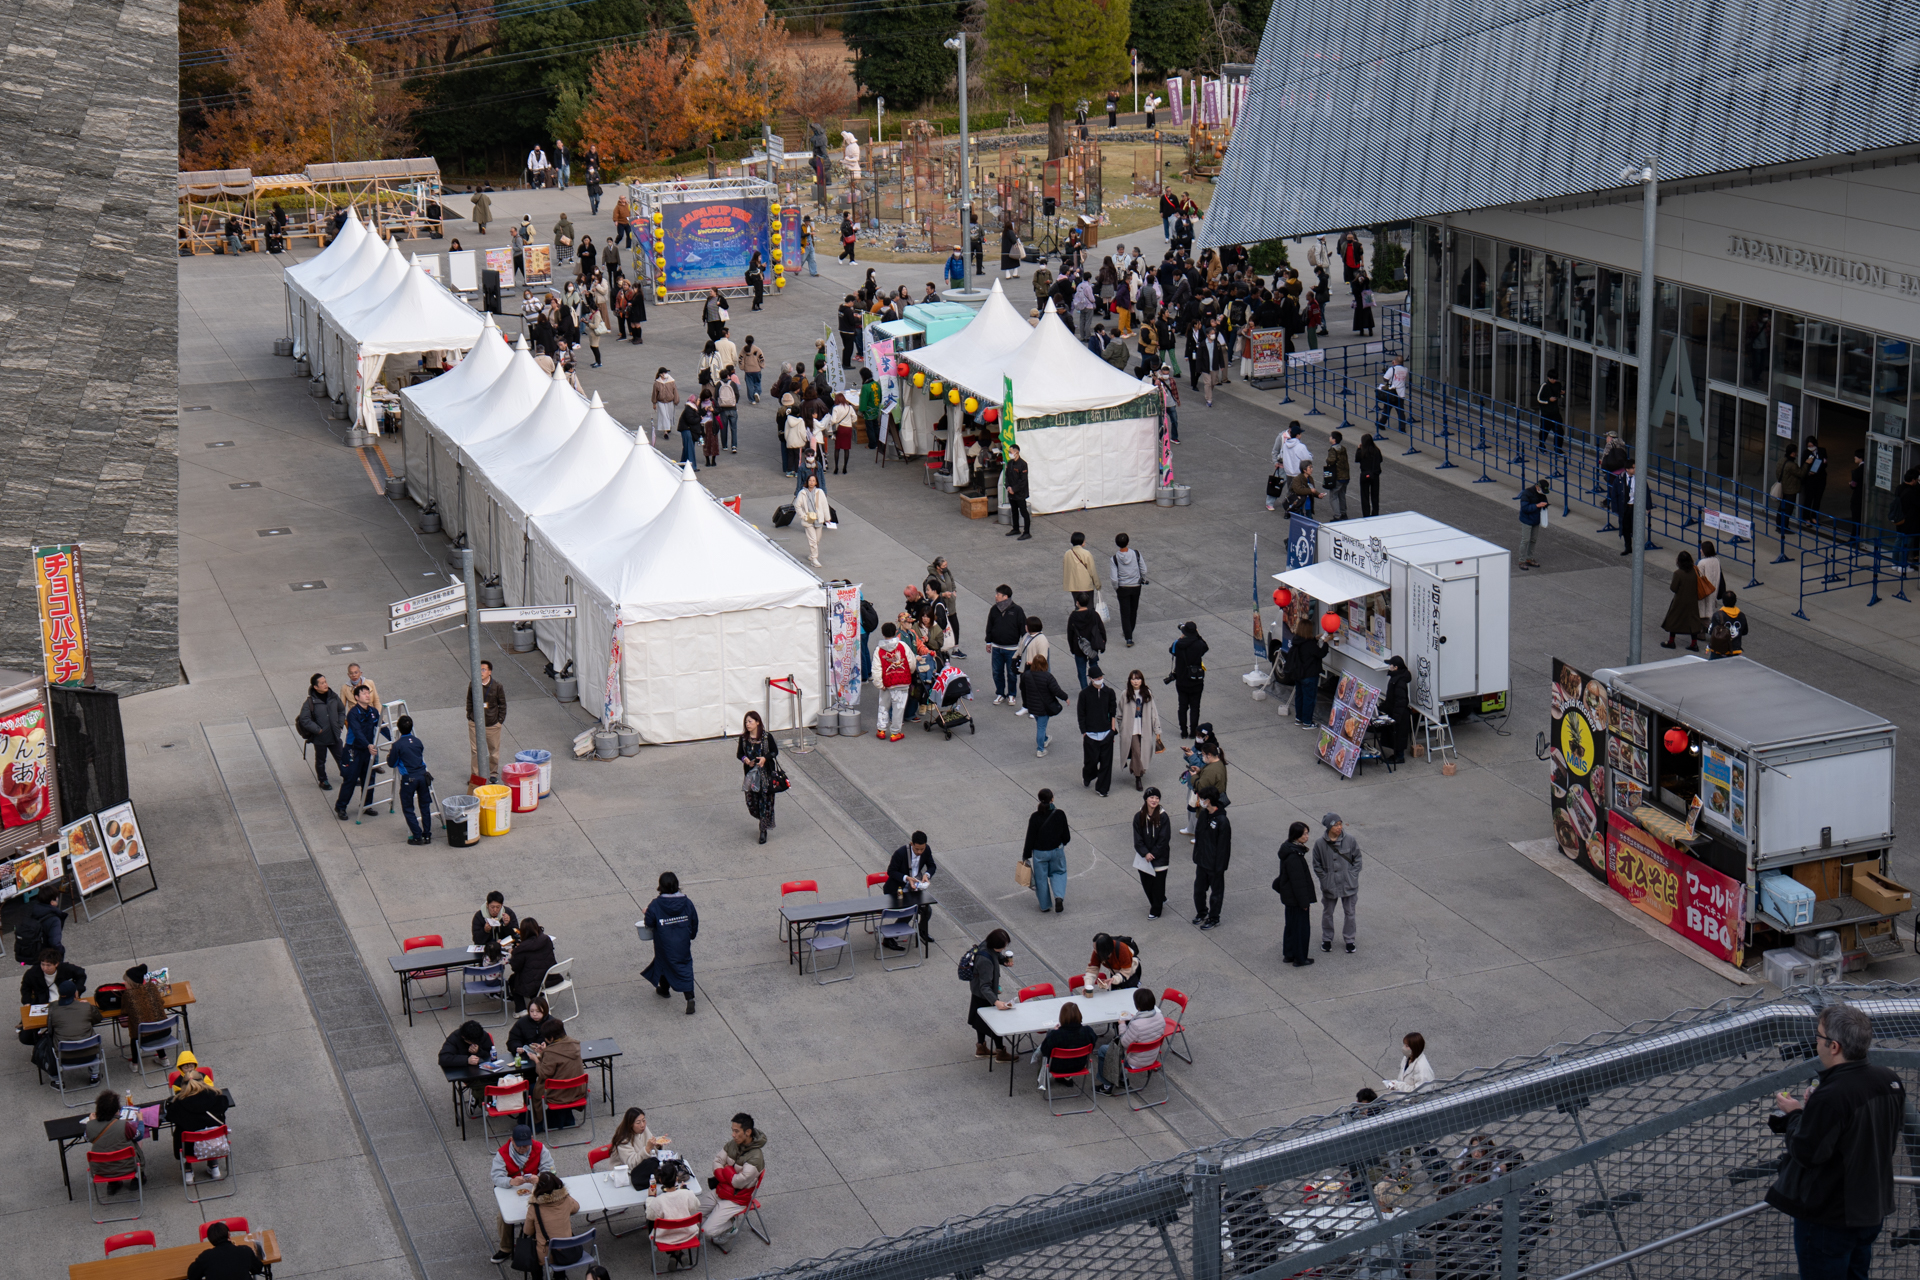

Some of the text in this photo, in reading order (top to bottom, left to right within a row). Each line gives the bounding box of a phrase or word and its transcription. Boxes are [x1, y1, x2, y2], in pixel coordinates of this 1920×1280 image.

[679, 205, 752, 228] JAPANUP FES
[700, 216, 731, 228] 2025
[1727, 235, 1788, 268] JAPAN
[1791, 250, 1886, 290] PAVILION
[1650, 335, 1704, 443] A
[43, 551, 80, 685] チョコバナナ
[1559, 699, 1576, 713] World
[1576, 700, 1597, 732] Kitchen
[1567, 751, 1588, 773] MAIS
[1617, 847, 1678, 910] オムそば
[1686, 870, 1735, 914] ワールド
[1686, 906, 1734, 951] BBQ
[1692, 898, 1727, 920] バーベキュー
